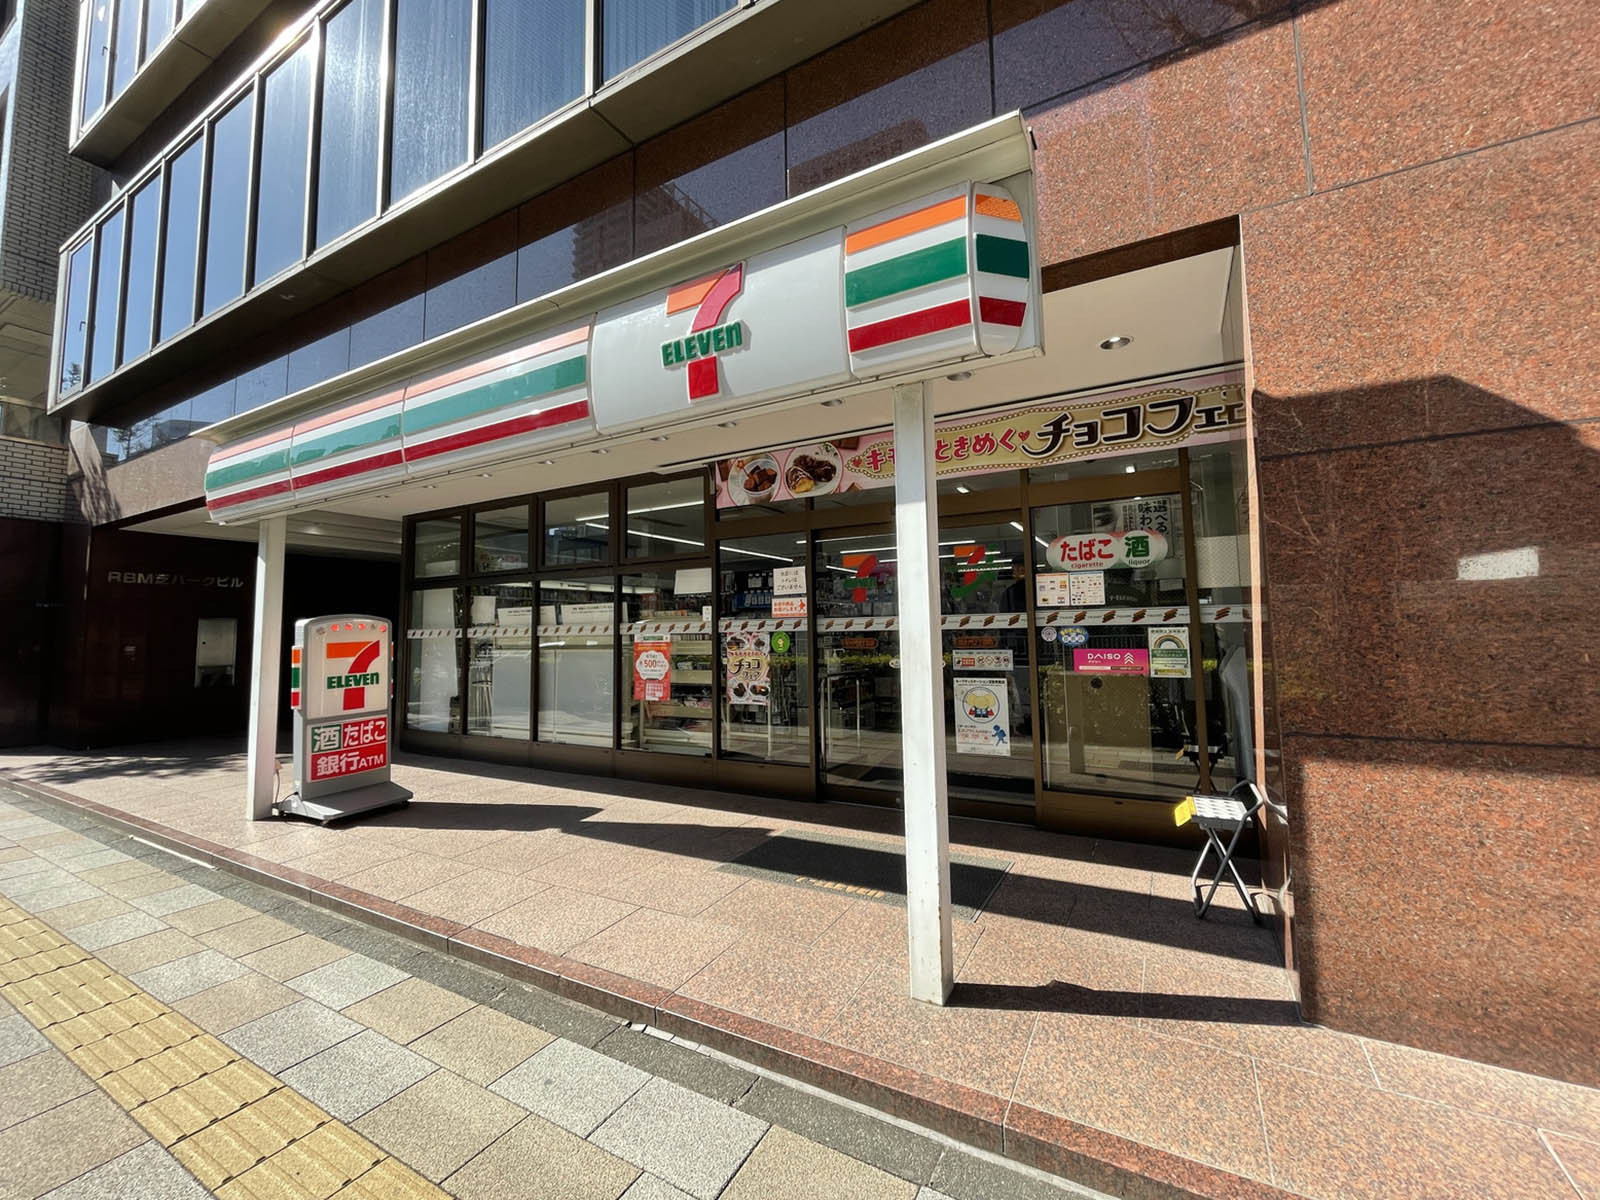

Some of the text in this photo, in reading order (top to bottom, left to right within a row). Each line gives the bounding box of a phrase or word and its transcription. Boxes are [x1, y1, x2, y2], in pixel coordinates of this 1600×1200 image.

[935, 428, 1016, 461] ときめく
[1021, 392, 1229, 457] チョコフェ
[1060, 535, 1149, 562] たばこ 酒
[644, 660, 657, 668] 500
[728, 658, 760, 674] チョコ
[313, 720, 386, 752] 酒 たばこ
